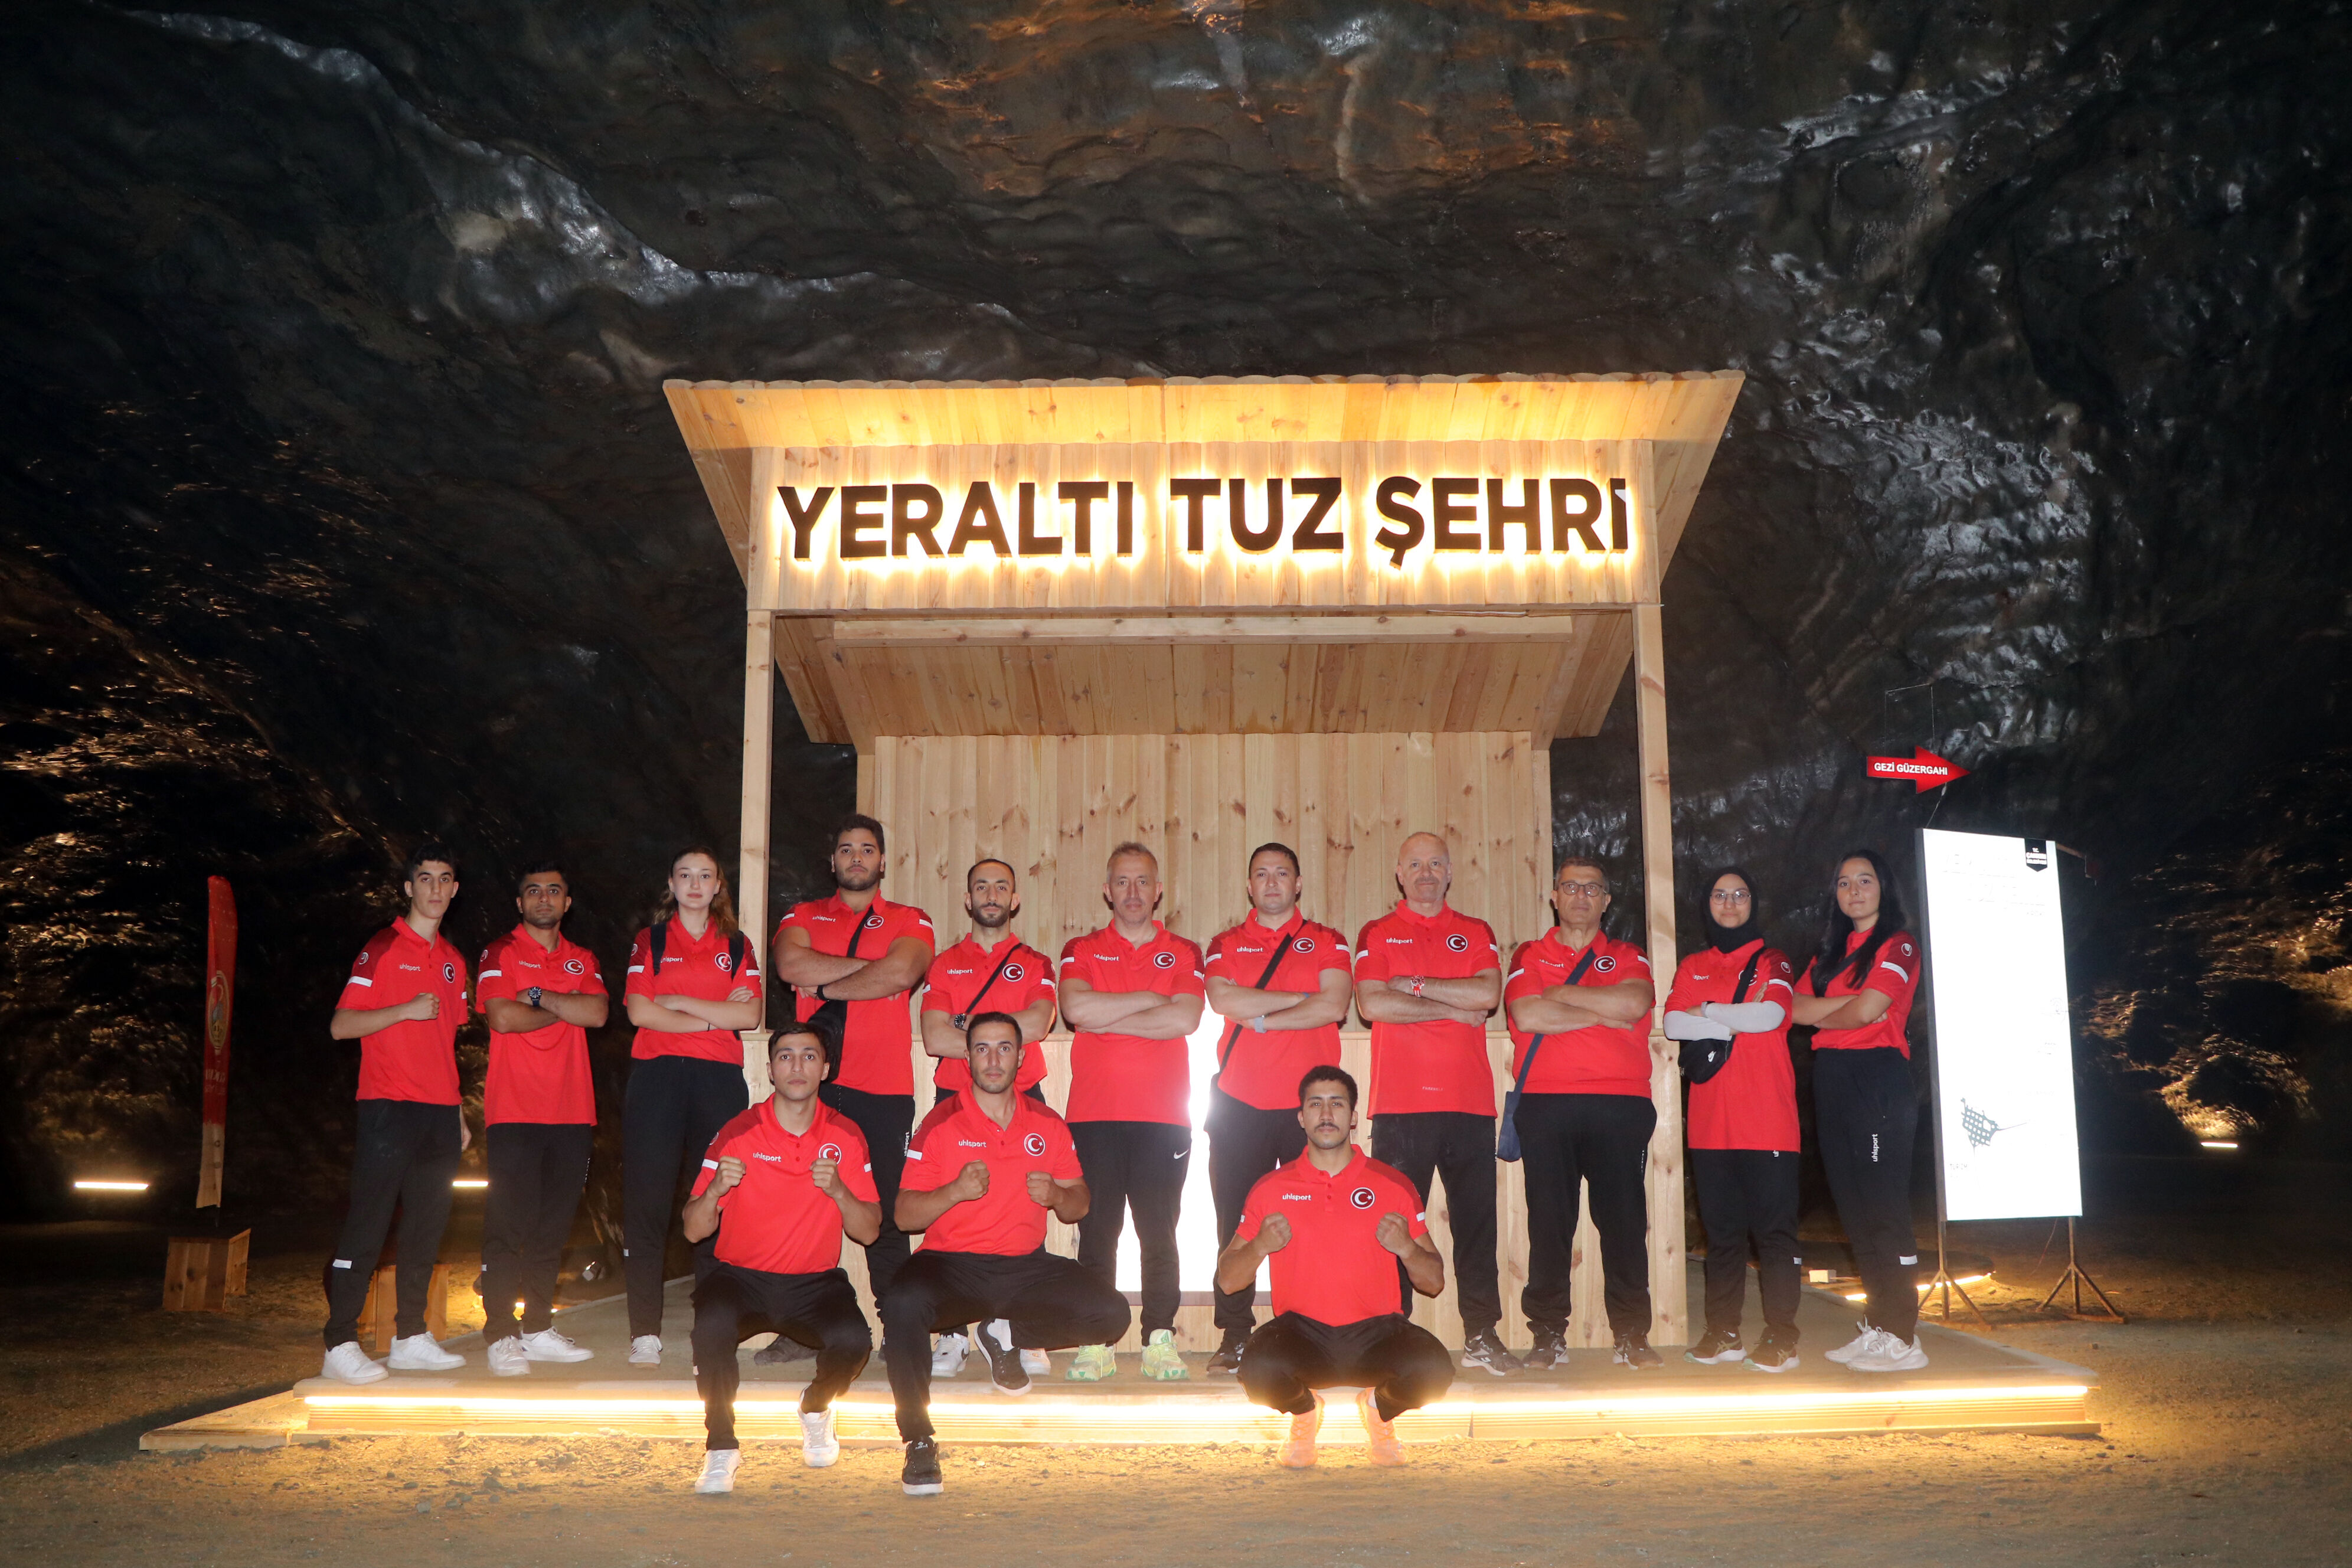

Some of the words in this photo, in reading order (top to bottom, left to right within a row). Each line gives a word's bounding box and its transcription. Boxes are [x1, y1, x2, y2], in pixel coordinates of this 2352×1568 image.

[777, 481, 1133, 561] YERALTI
[1170, 477, 1344, 555] TUZ
[1374, 476, 1628, 570] ŞEHRİ
[1874, 762, 1895, 772] GEZİ
[1896, 763, 1948, 775] GÜZERGAHI
[1093, 953, 1119, 962] uhlsport
[399, 963, 421, 972] uhlsport
[519, 961, 541, 969] uhlsport
[959, 1139, 986, 1148] uhlsport
[1871, 1133, 1880, 1162] uhlsport
[753, 1152, 782, 1162] uhlsport
[1282, 1193, 1312, 1201] uhlsport
